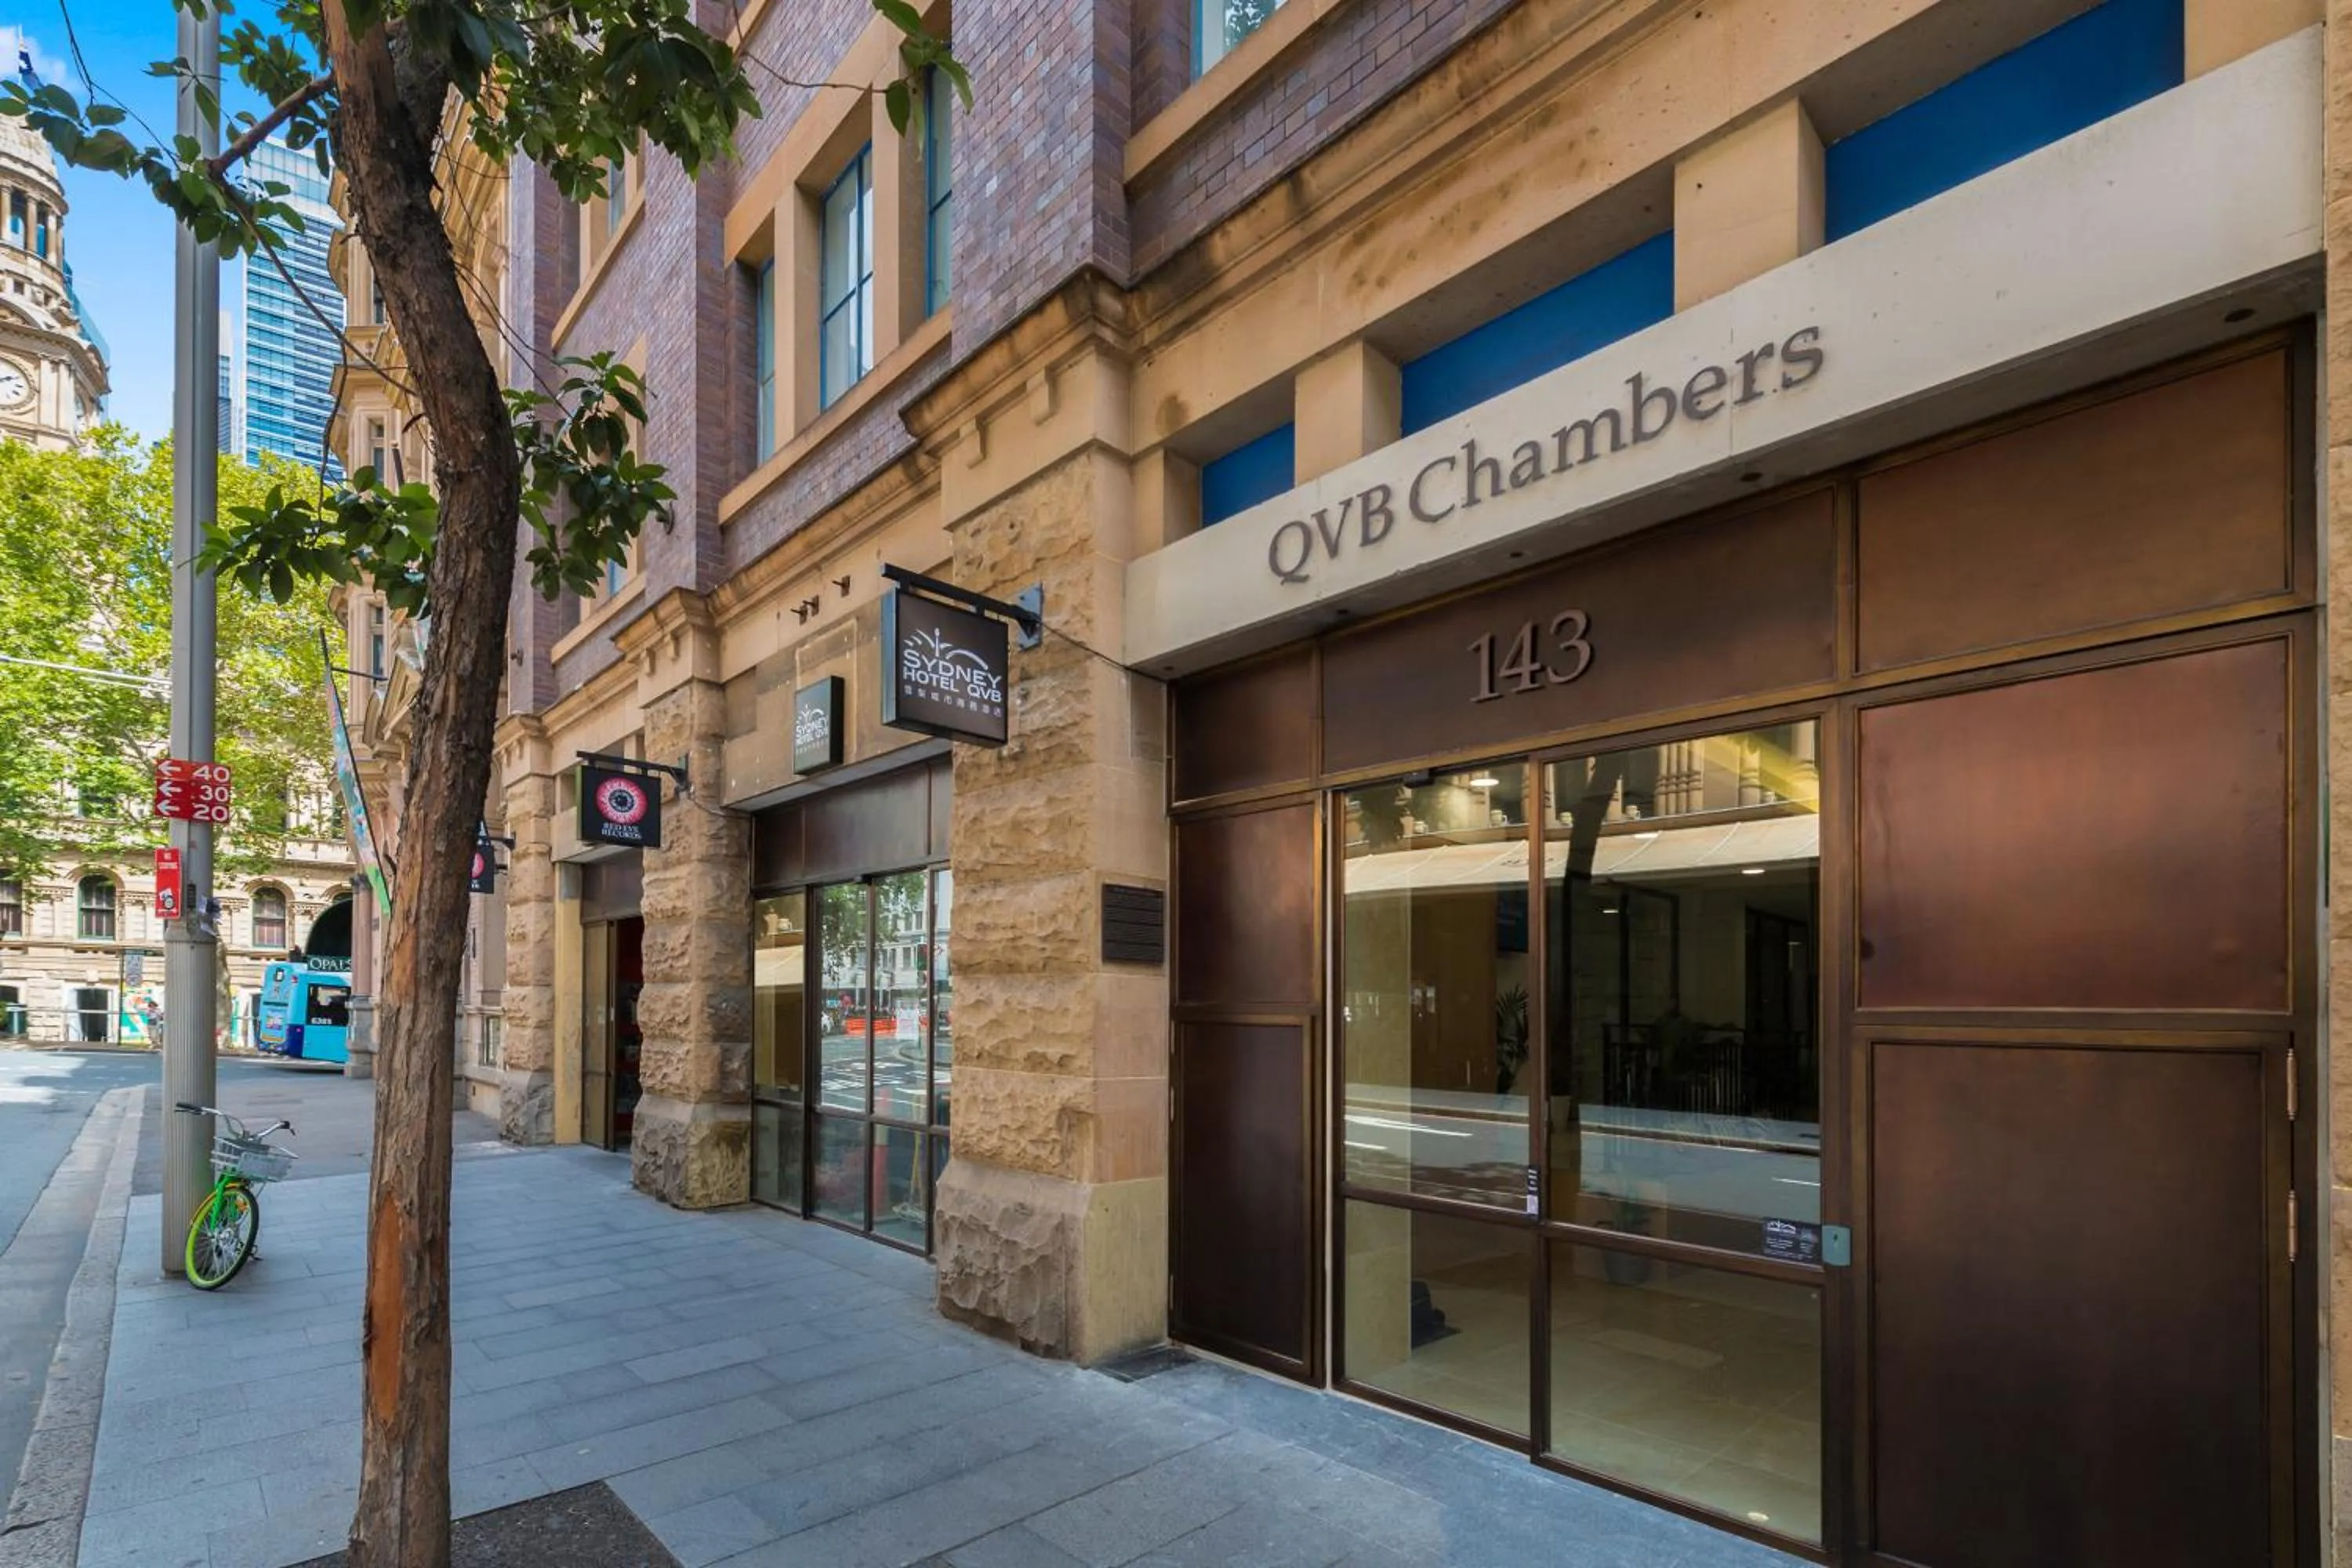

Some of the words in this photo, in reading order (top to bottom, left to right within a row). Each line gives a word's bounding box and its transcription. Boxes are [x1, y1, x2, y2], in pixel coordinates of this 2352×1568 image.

[1268, 482, 1396, 585] QVB
[1408, 325, 1825, 524] Chambers
[903, 648, 1002, 688] SYDNEY
[1466, 608, 1592, 704] 143
[903, 667, 960, 693] HOTEL
[967, 682, 1002, 702] QVB
[796, 717, 827, 735] SYDNEY
[193, 764, 230, 782] 40
[200, 785, 229, 802] 30
[193, 804, 228, 822] 20
